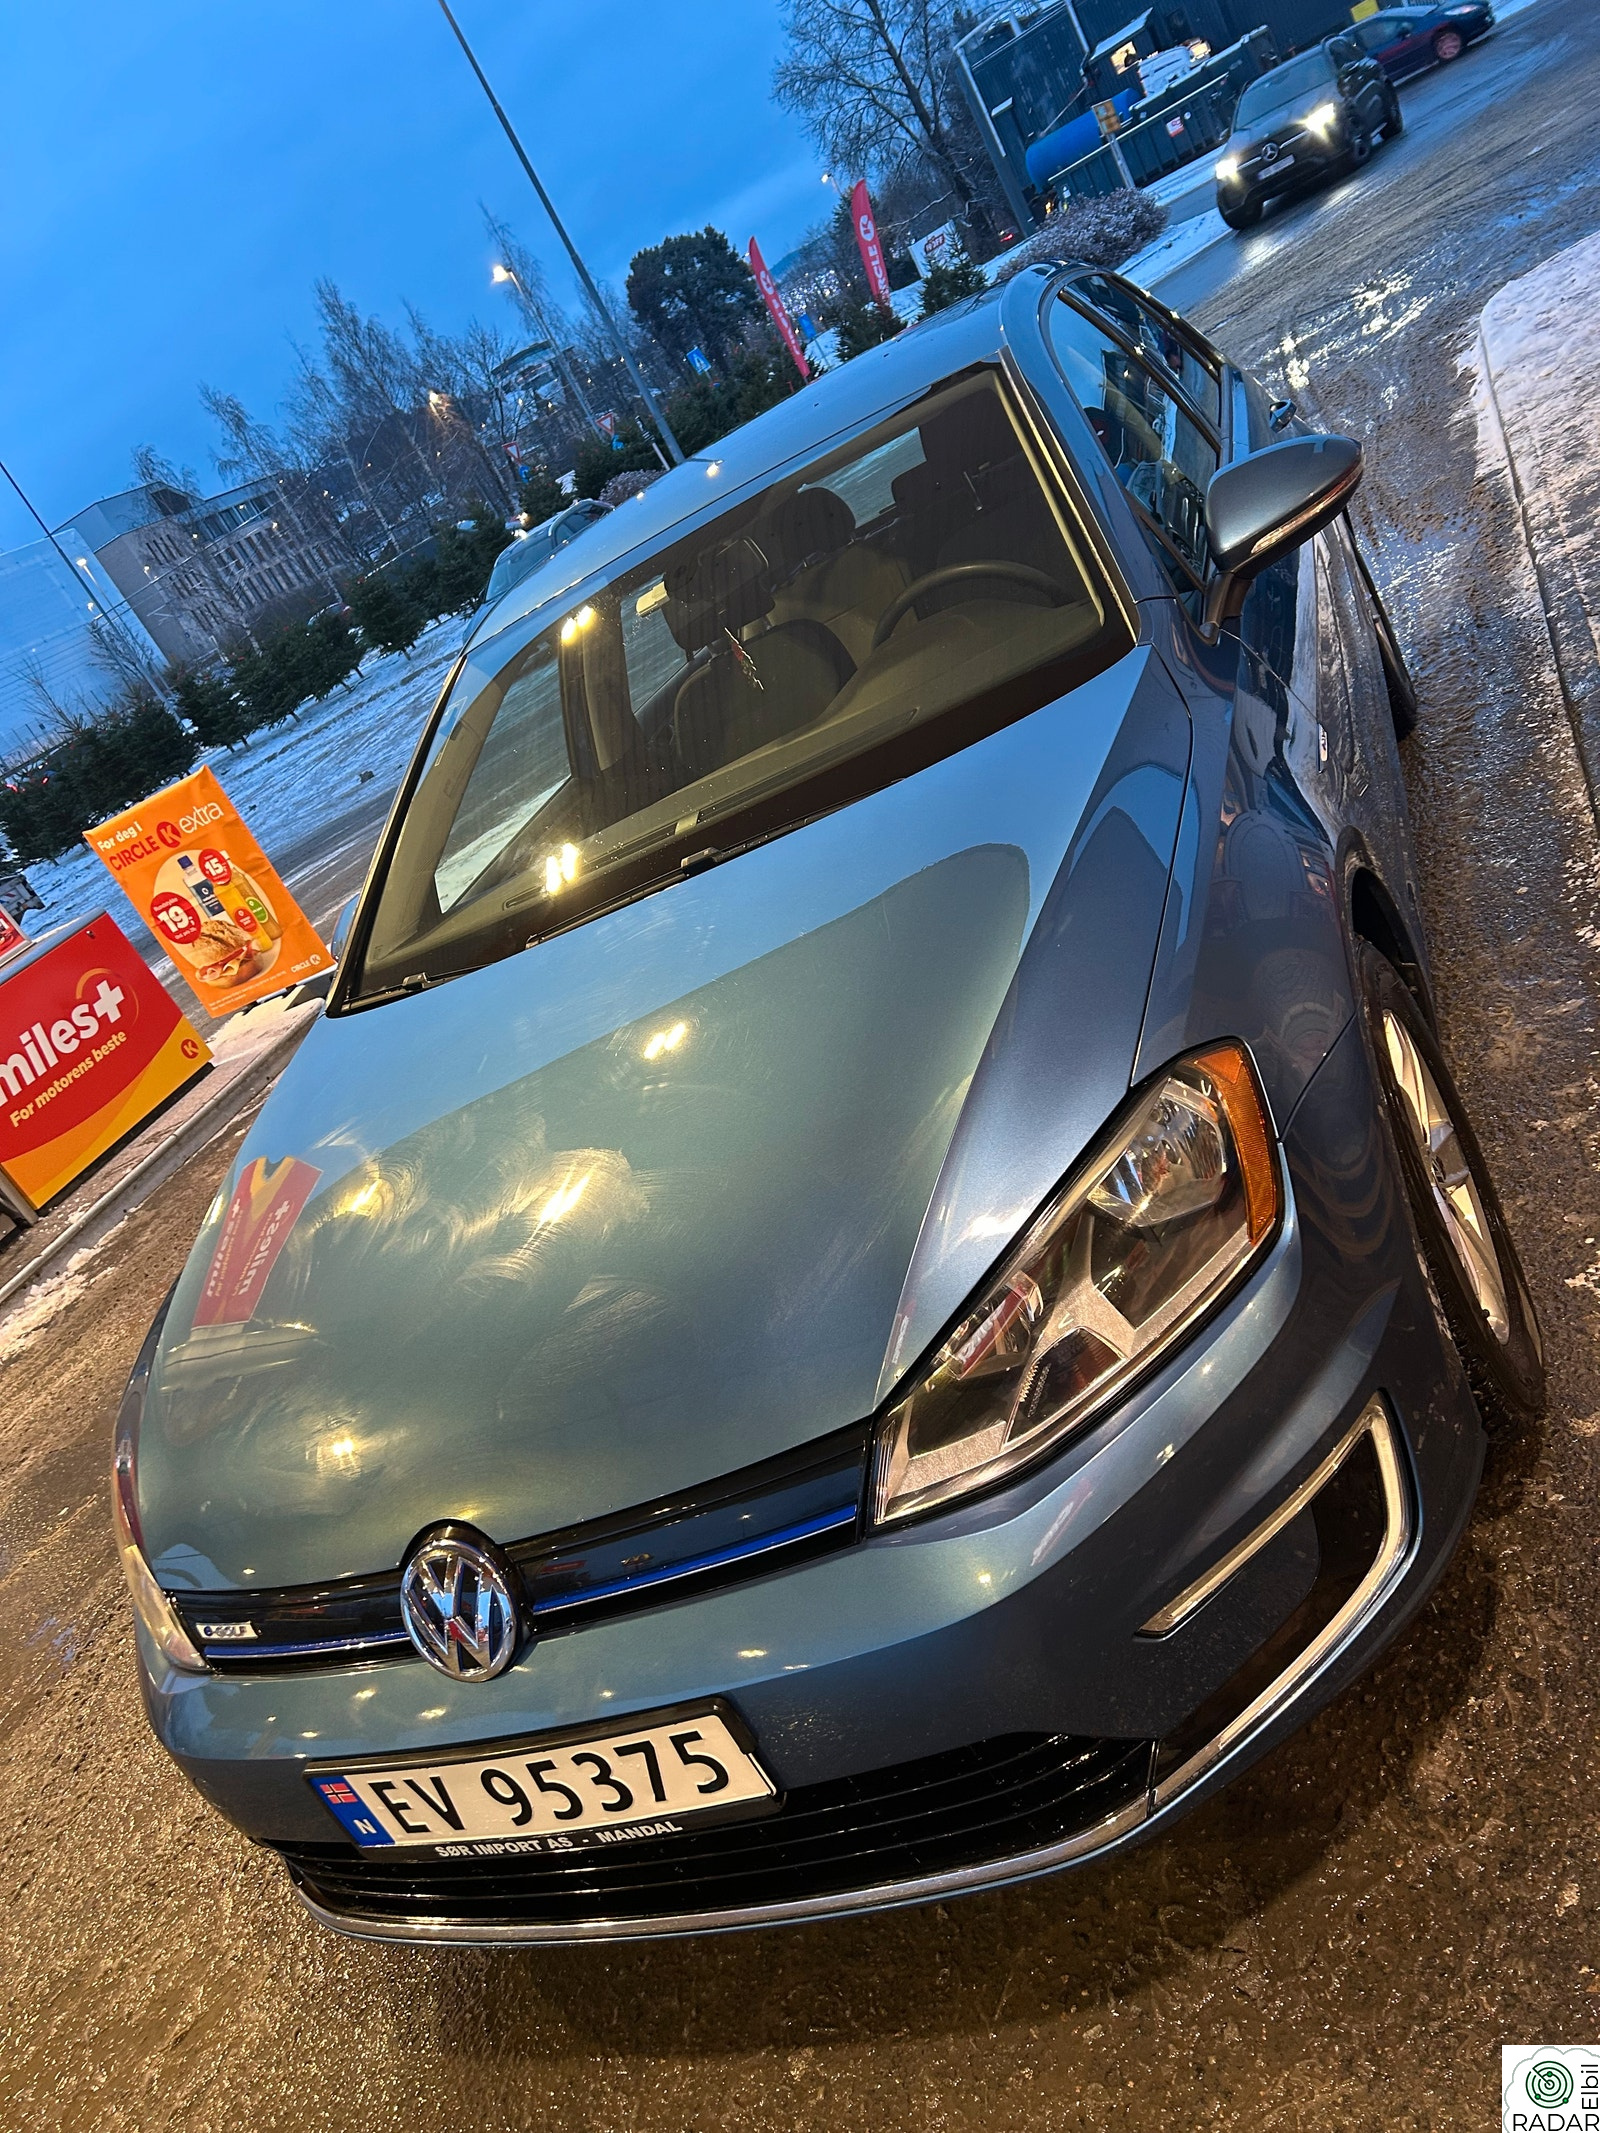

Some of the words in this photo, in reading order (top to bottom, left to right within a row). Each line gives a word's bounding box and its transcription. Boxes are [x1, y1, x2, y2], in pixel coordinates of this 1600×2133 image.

[97, 837, 116, 852] For
[115, 826, 138, 842] deg
[108, 835, 160, 871] CIRCLE
[158, 823, 181, 846] K
[178, 802, 224, 834] extra
[181, 1038, 199, 1060] K
[9, 1104, 35, 1128] For
[34, 1056, 95, 1108] motorens
[94, 1030, 127, 1063] beste
[367, 1775, 466, 1834] EV
[479, 1730, 730, 1827] 95375
[353, 1818, 377, 1835] N
[434, 1844, 471, 1857] SØR
[472, 1839, 542, 1856] IMPORT
[548, 1836, 574, 1849] AS
[595, 1820, 683, 1844] MANDAL
